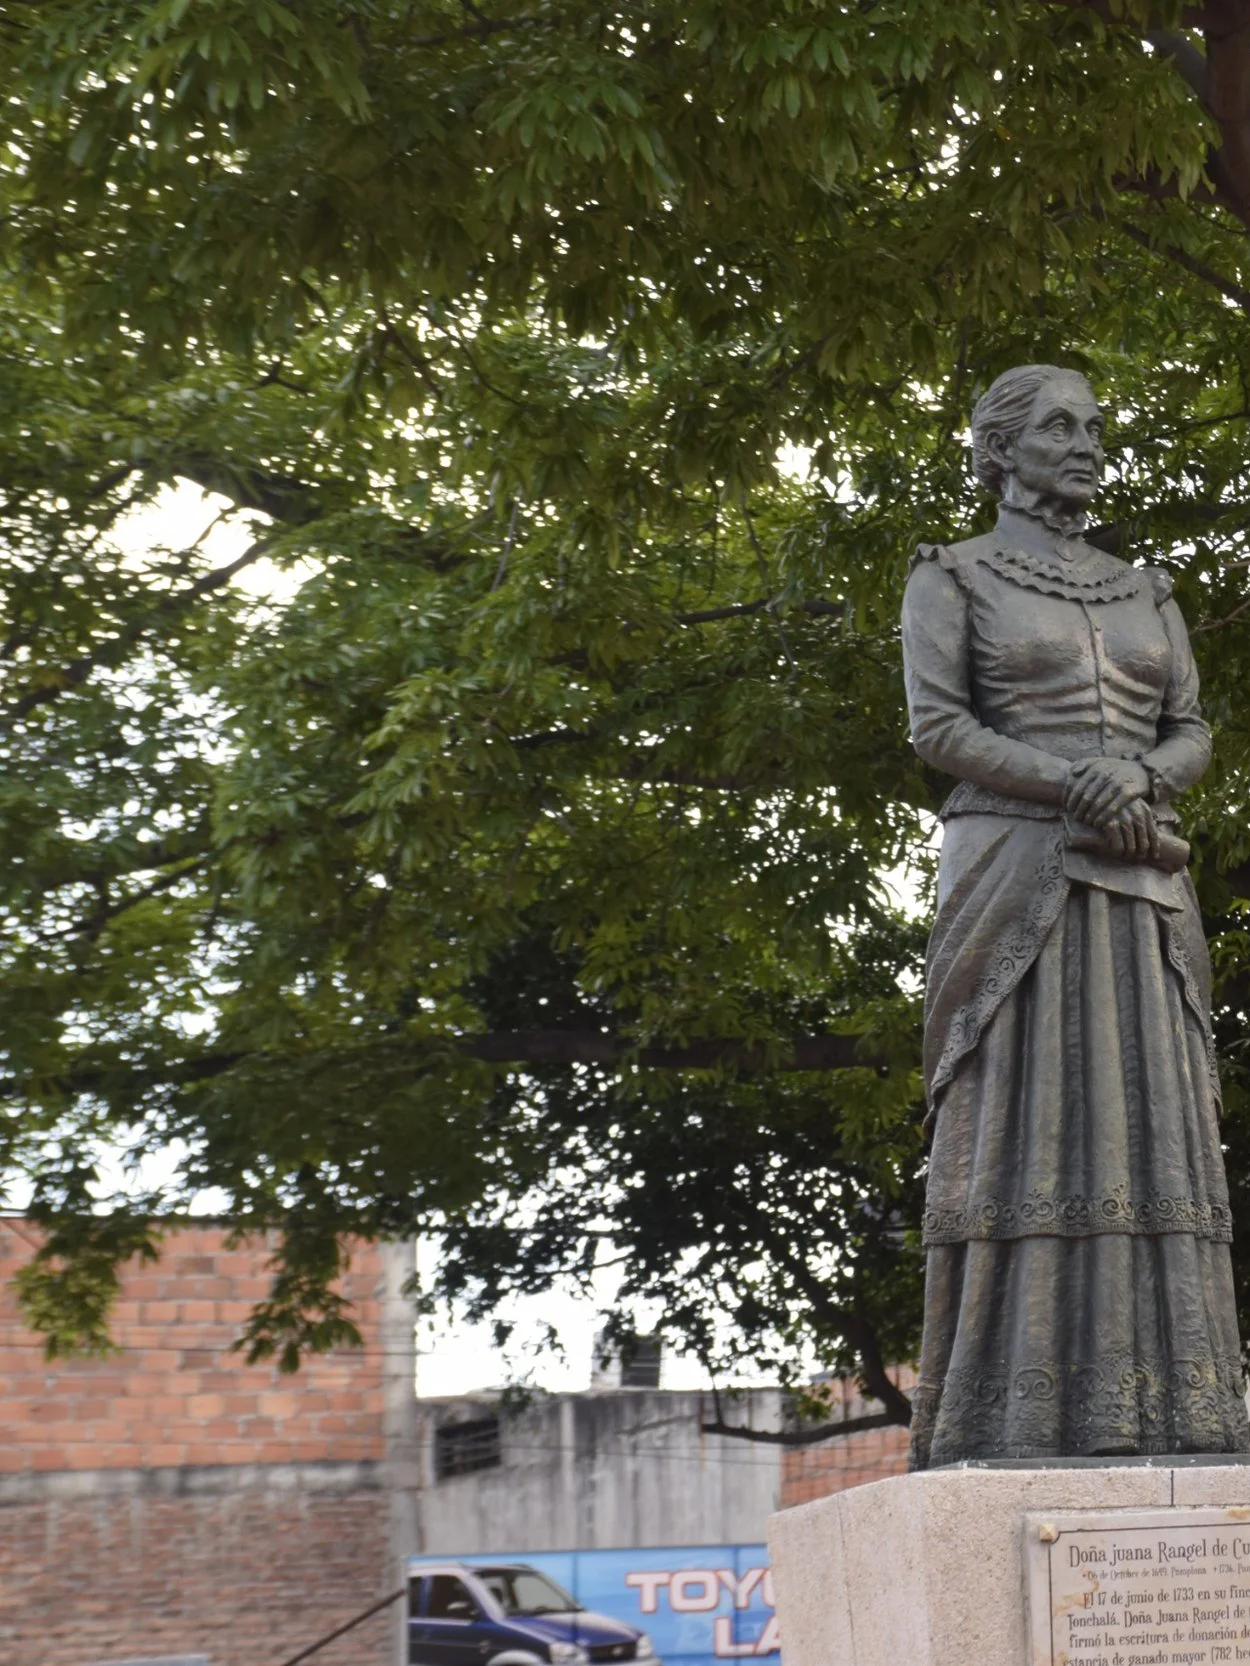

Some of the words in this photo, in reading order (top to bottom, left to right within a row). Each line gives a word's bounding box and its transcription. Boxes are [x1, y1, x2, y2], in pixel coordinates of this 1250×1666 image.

[1069, 1545, 1107, 1568] Doña
[1158, 1539, 1206, 1563] Rangel
[1212, 1538, 1228, 1556] de
[1141, 1567, 1151, 1577] de
[1083, 1591, 1093, 1609] El
[1097, 1591, 1107, 1605] 17
[1111, 1590, 1123, 1605] de
[1157, 1588, 1170, 1602] de
[1173, 1587, 1194, 1602] 1733
[1198, 1590, 1211, 1600] en
[1214, 1589, 1226, 1600] su
[1124, 1610, 1153, 1629] Doña
[1156, 1608, 1188, 1626] Juana
[1192, 1604, 1230, 1625] Rangel
[1233, 1604, 1246, 1619] de
[1069, 1632, 1102, 1649] firmó
[1105, 1632, 1115, 1647] la
[1118, 1629, 1169, 1646] escritura
[1172, 1628, 1186, 1642] de
[1188, 1625, 1238, 1642] donación
[1112, 1651, 1126, 1665] de
[1128, 1649, 1169, 1666] ganado
[1171, 1651, 1207, 1666] mayor
